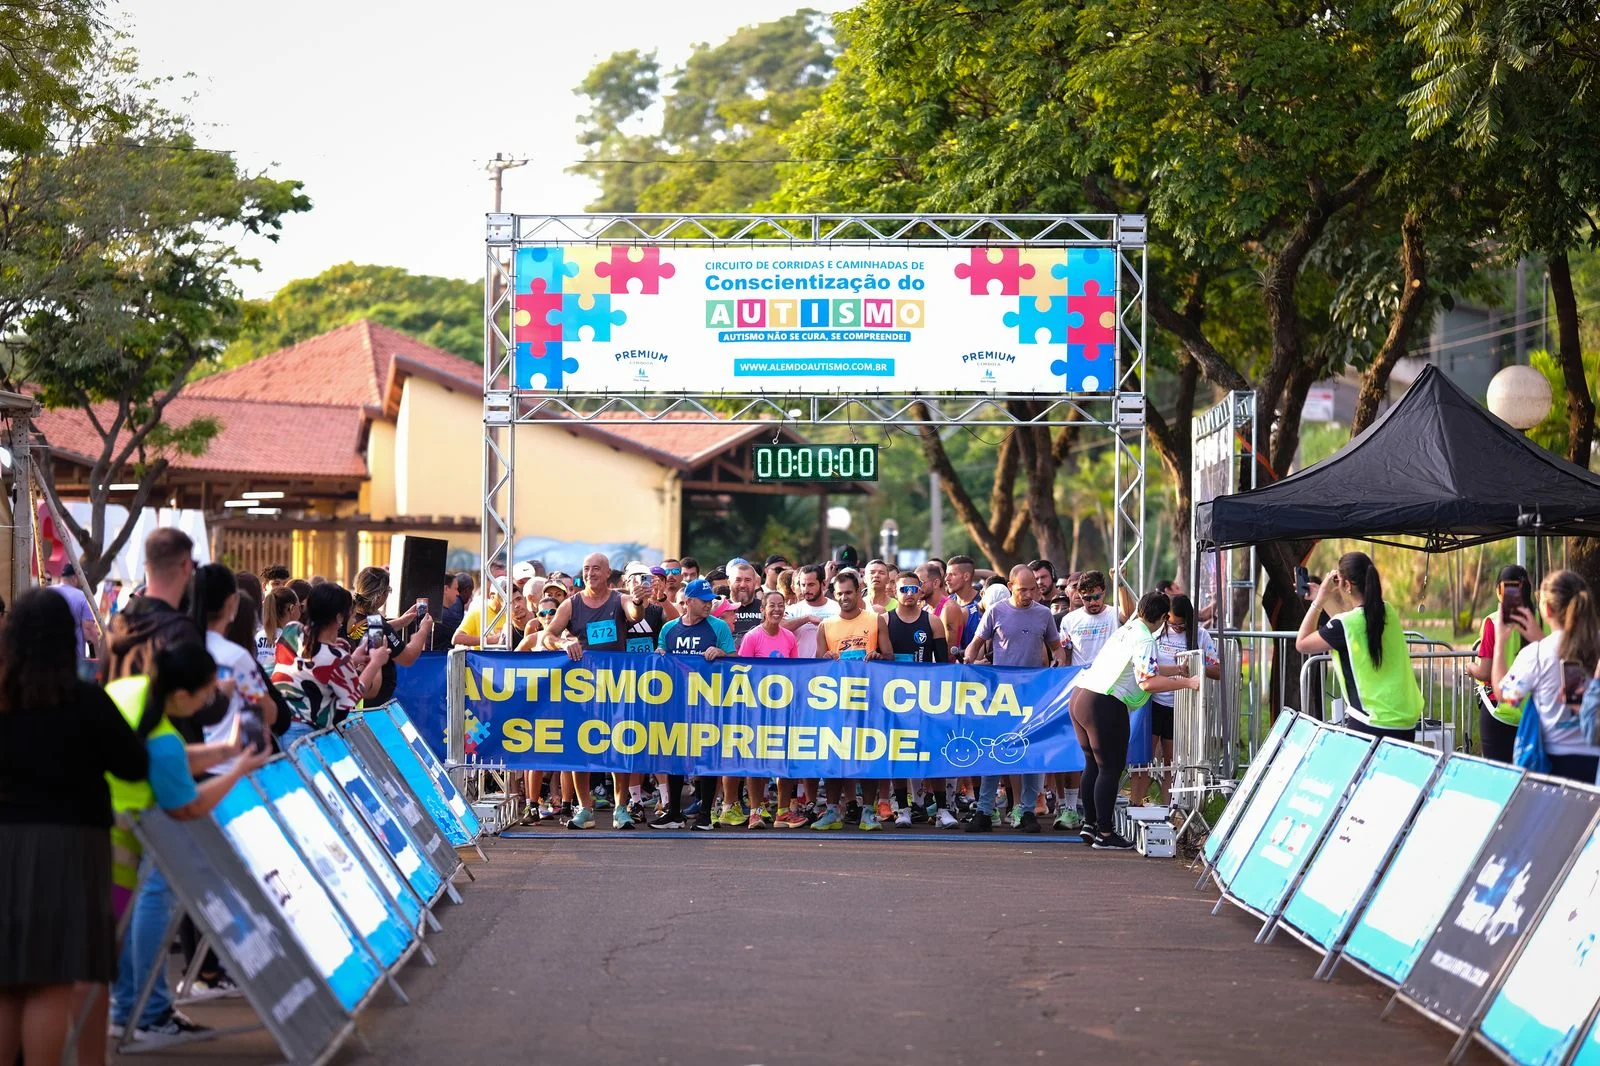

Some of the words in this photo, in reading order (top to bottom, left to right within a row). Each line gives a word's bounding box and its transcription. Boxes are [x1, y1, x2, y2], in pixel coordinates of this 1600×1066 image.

[705, 261, 753, 270] CIRCUITO
[756, 261, 769, 269] DE
[772, 261, 824, 269] CORRIDAS
[827, 261, 833, 269] E
[836, 261, 908, 269] CAMINHADAS
[911, 262, 924, 270] DE
[705, 274, 890, 293] Conscientização
[898, 275, 925, 290] do
[710, 302, 922, 325] AUTISMO
[723, 332, 764, 341] AUTISMO
[767, 331, 787, 340] NÃO
[789, 332, 799, 340] SE
[802, 332, 828, 341] CURA,
[831, 332, 841, 340] SE
[843, 332, 906, 340] COMPREENDE!
[615, 350, 668, 362] PREMIUM
[962, 351, 1015, 363] PREMIUM
[740, 363, 887, 372] WWW.ALEMDOAUTISMO.COM.BR
[757, 448, 874, 477] 00:00:00
[592, 627, 613, 639] 472
[630, 644, 651, 653] 368
[676, 636, 701, 649] MF
[687, 664, 794, 710] NÃO
[807, 675, 869, 711] SE
[882, 678, 1034, 723] CURA,
[502, 718, 564, 754] SE
[577, 719, 931, 763] COMPREENDE.
